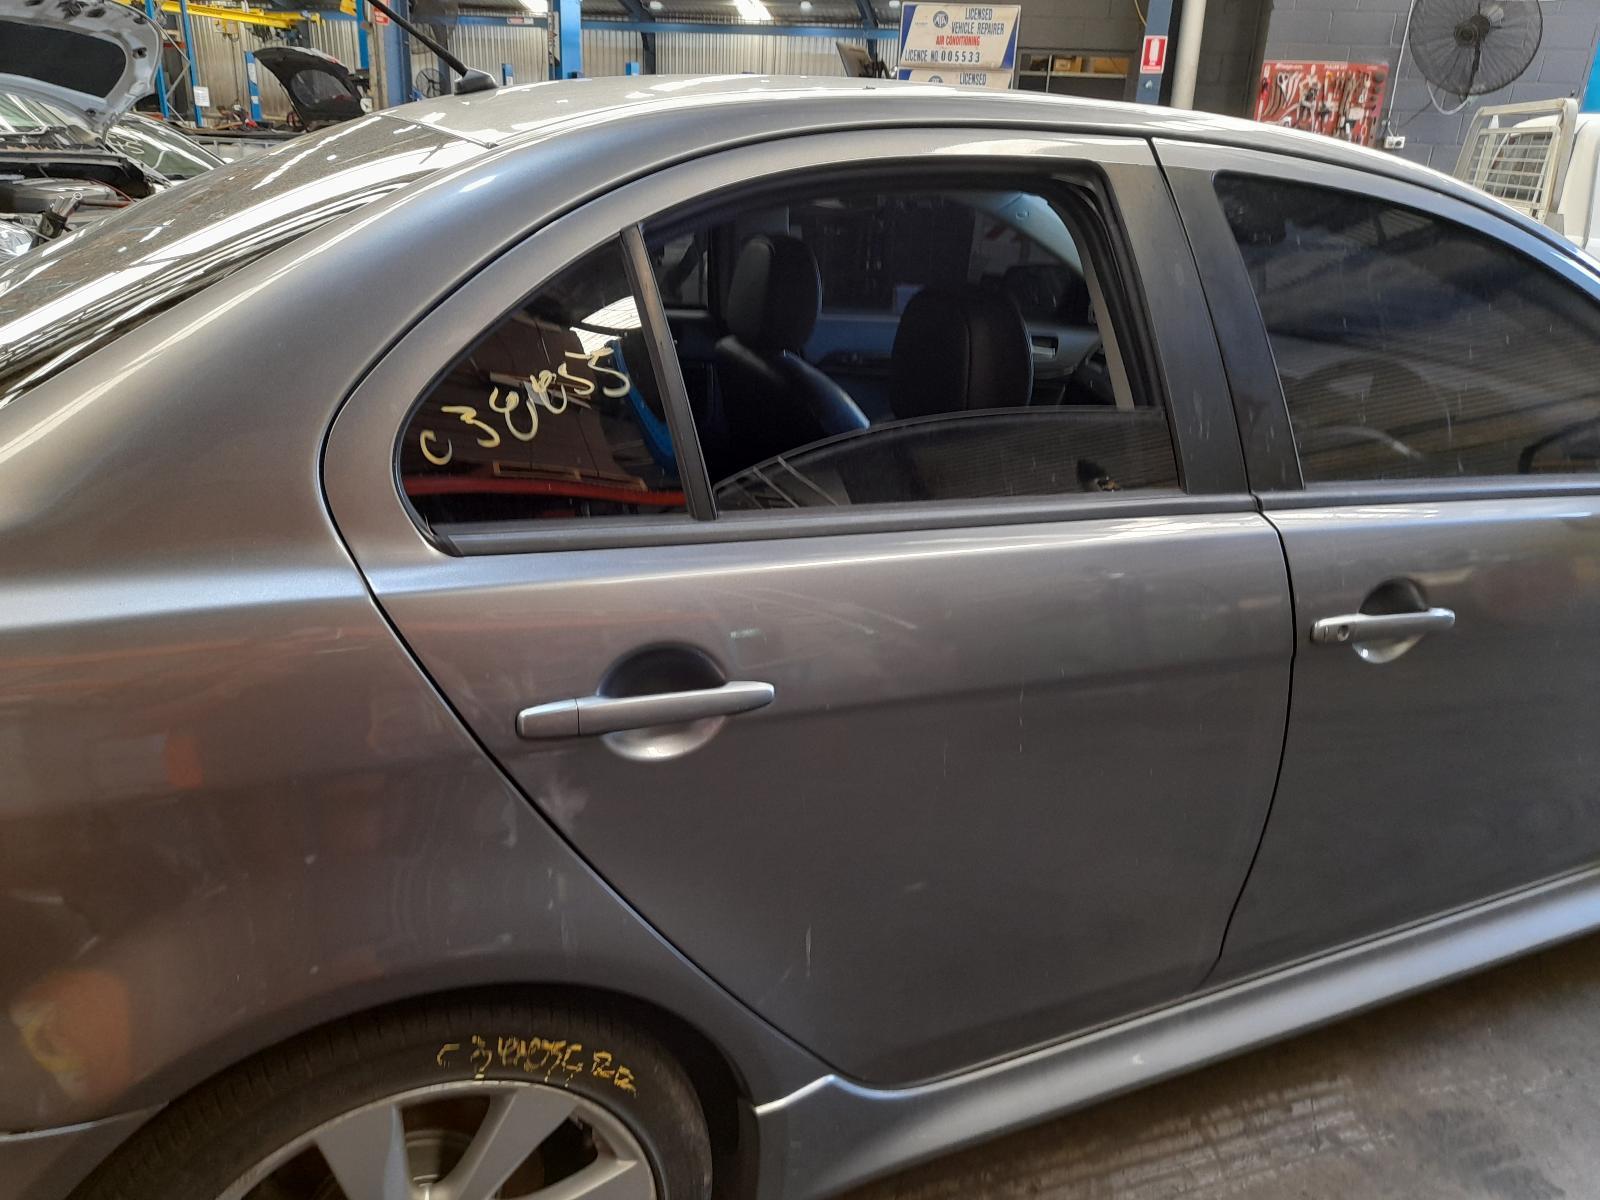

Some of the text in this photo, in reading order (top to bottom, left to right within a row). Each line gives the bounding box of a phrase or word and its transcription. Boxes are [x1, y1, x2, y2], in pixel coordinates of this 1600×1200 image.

[965, 7, 993, 21] LICENSED
[951, 21, 1005, 35] VEHICLE REPAIRER
[935, 35, 945, 46] AIR
[904, 48, 928, 62] LICENCE
[959, 72, 987, 86] LICENSED
